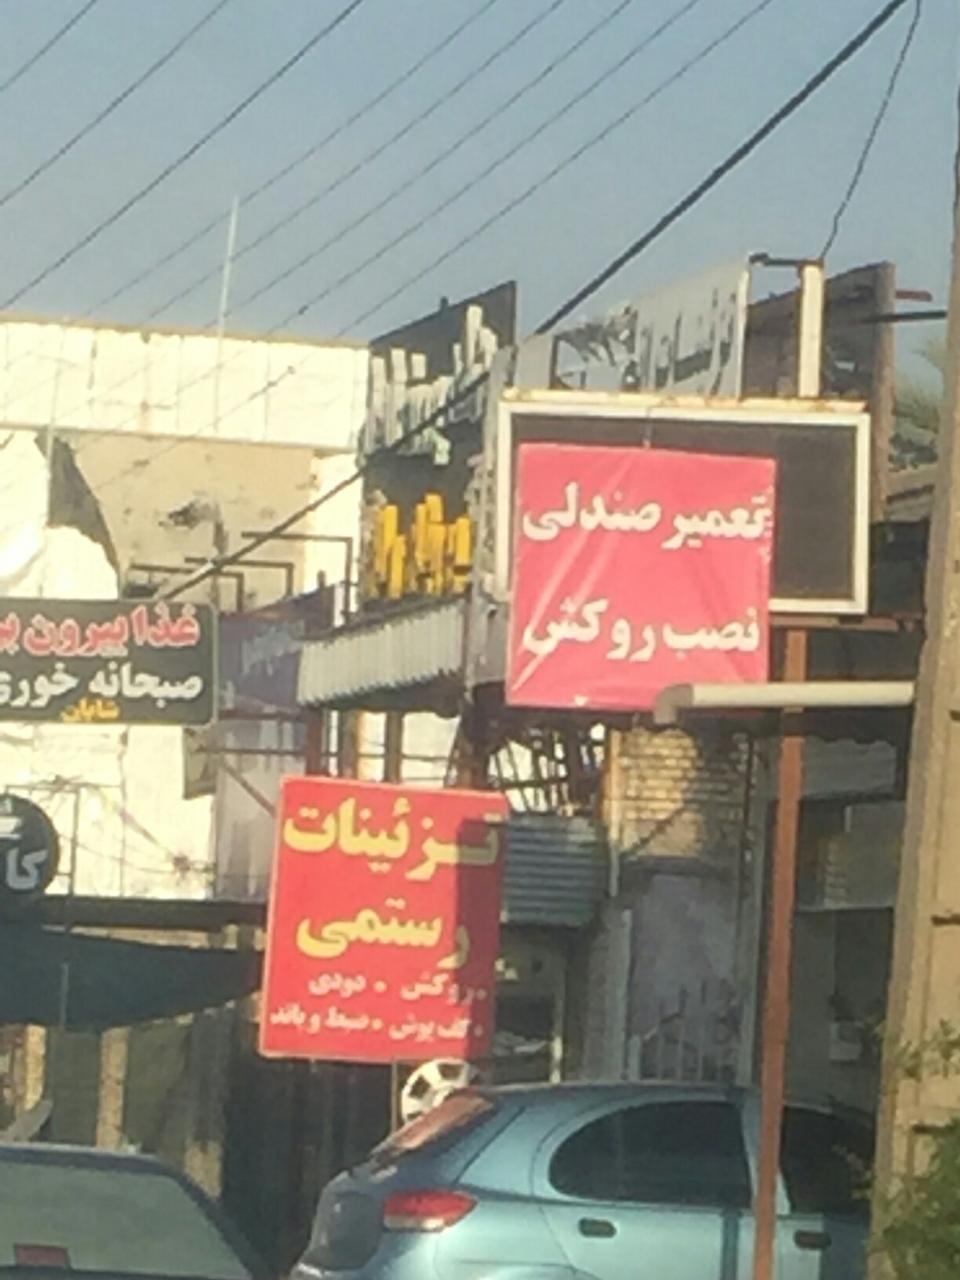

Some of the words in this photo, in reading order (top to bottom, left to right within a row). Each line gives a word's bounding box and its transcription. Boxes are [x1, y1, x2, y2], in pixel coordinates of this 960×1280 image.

[522, 481, 662, 541] صندلی
[661, 492, 773, 549] تعمیر
[23, 613, 130, 657] بیرون
[131, 602, 200, 646] غذا
[522, 596, 656, 661] روکش
[662, 605, 760, 661] نصب
[89, 661, 203, 709] صبحانه
[283, 797, 502, 882] تزئینات
[296, 897, 471, 969] رستمی
